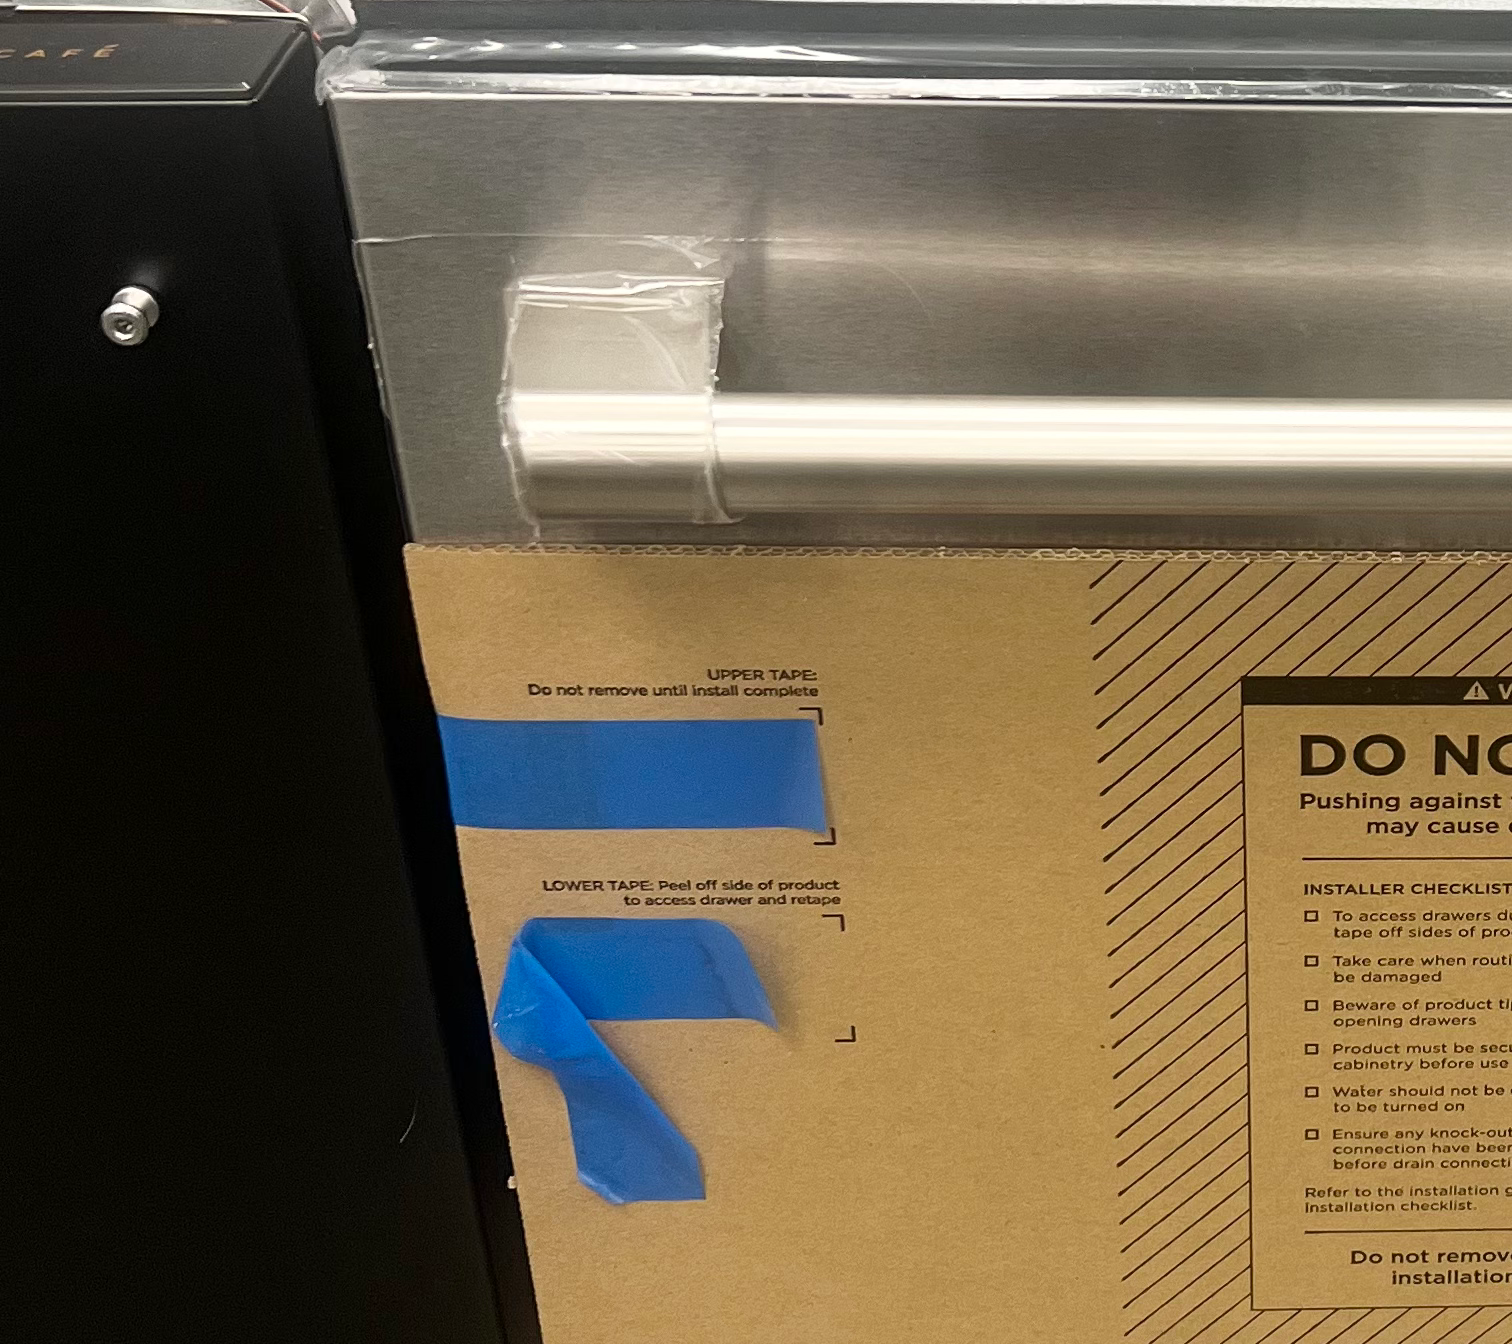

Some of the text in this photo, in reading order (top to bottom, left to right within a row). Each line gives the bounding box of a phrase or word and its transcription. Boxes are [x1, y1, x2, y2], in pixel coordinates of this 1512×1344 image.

[707, 669, 818, 681] UPPER TAPE:
[527, 683, 819, 698] Do not remove until install complete
[1300, 734, 1406, 776] DO
[1300, 792, 1400, 812] Pushing
[1410, 792, 1502, 812] against
[1367, 821, 1419, 837] may
[1427, 821, 1499, 834] cause
[542, 879, 840, 892] LOWER TAPE: Peel off side of product
[1304, 883, 1512, 895] INSTALLER CHECKLIST
[623, 894, 841, 906] to access drawer and retape
[1332, 910, 1353, 922] To
[1359, 913, 1416, 922] access
[1423, 910, 1491, 921] drawers
[1334, 927, 1372, 940] tape
[1379, 926, 1403, 938] off
[1409, 926, 1452, 938] sides
[1458, 926, 1476, 938] of
[1333, 1000, 1396, 1012] Beware
[1402, 999, 1419, 1010] of
[1425, 999, 1493, 1012] product
[1333, 1015, 1477, 1028] opening drawers
[1305, 1187, 1349, 1198] Refer
[1355, 1187, 1372, 1197] to
[1378, 1186, 1403, 1197] the
[1410, 1185, 1499, 1196] installation
[1305, 1200, 1479, 1213] installation checklist.
[1350, 1250, 1383, 1264] Do
[1391, 1250, 1429, 1264] not
